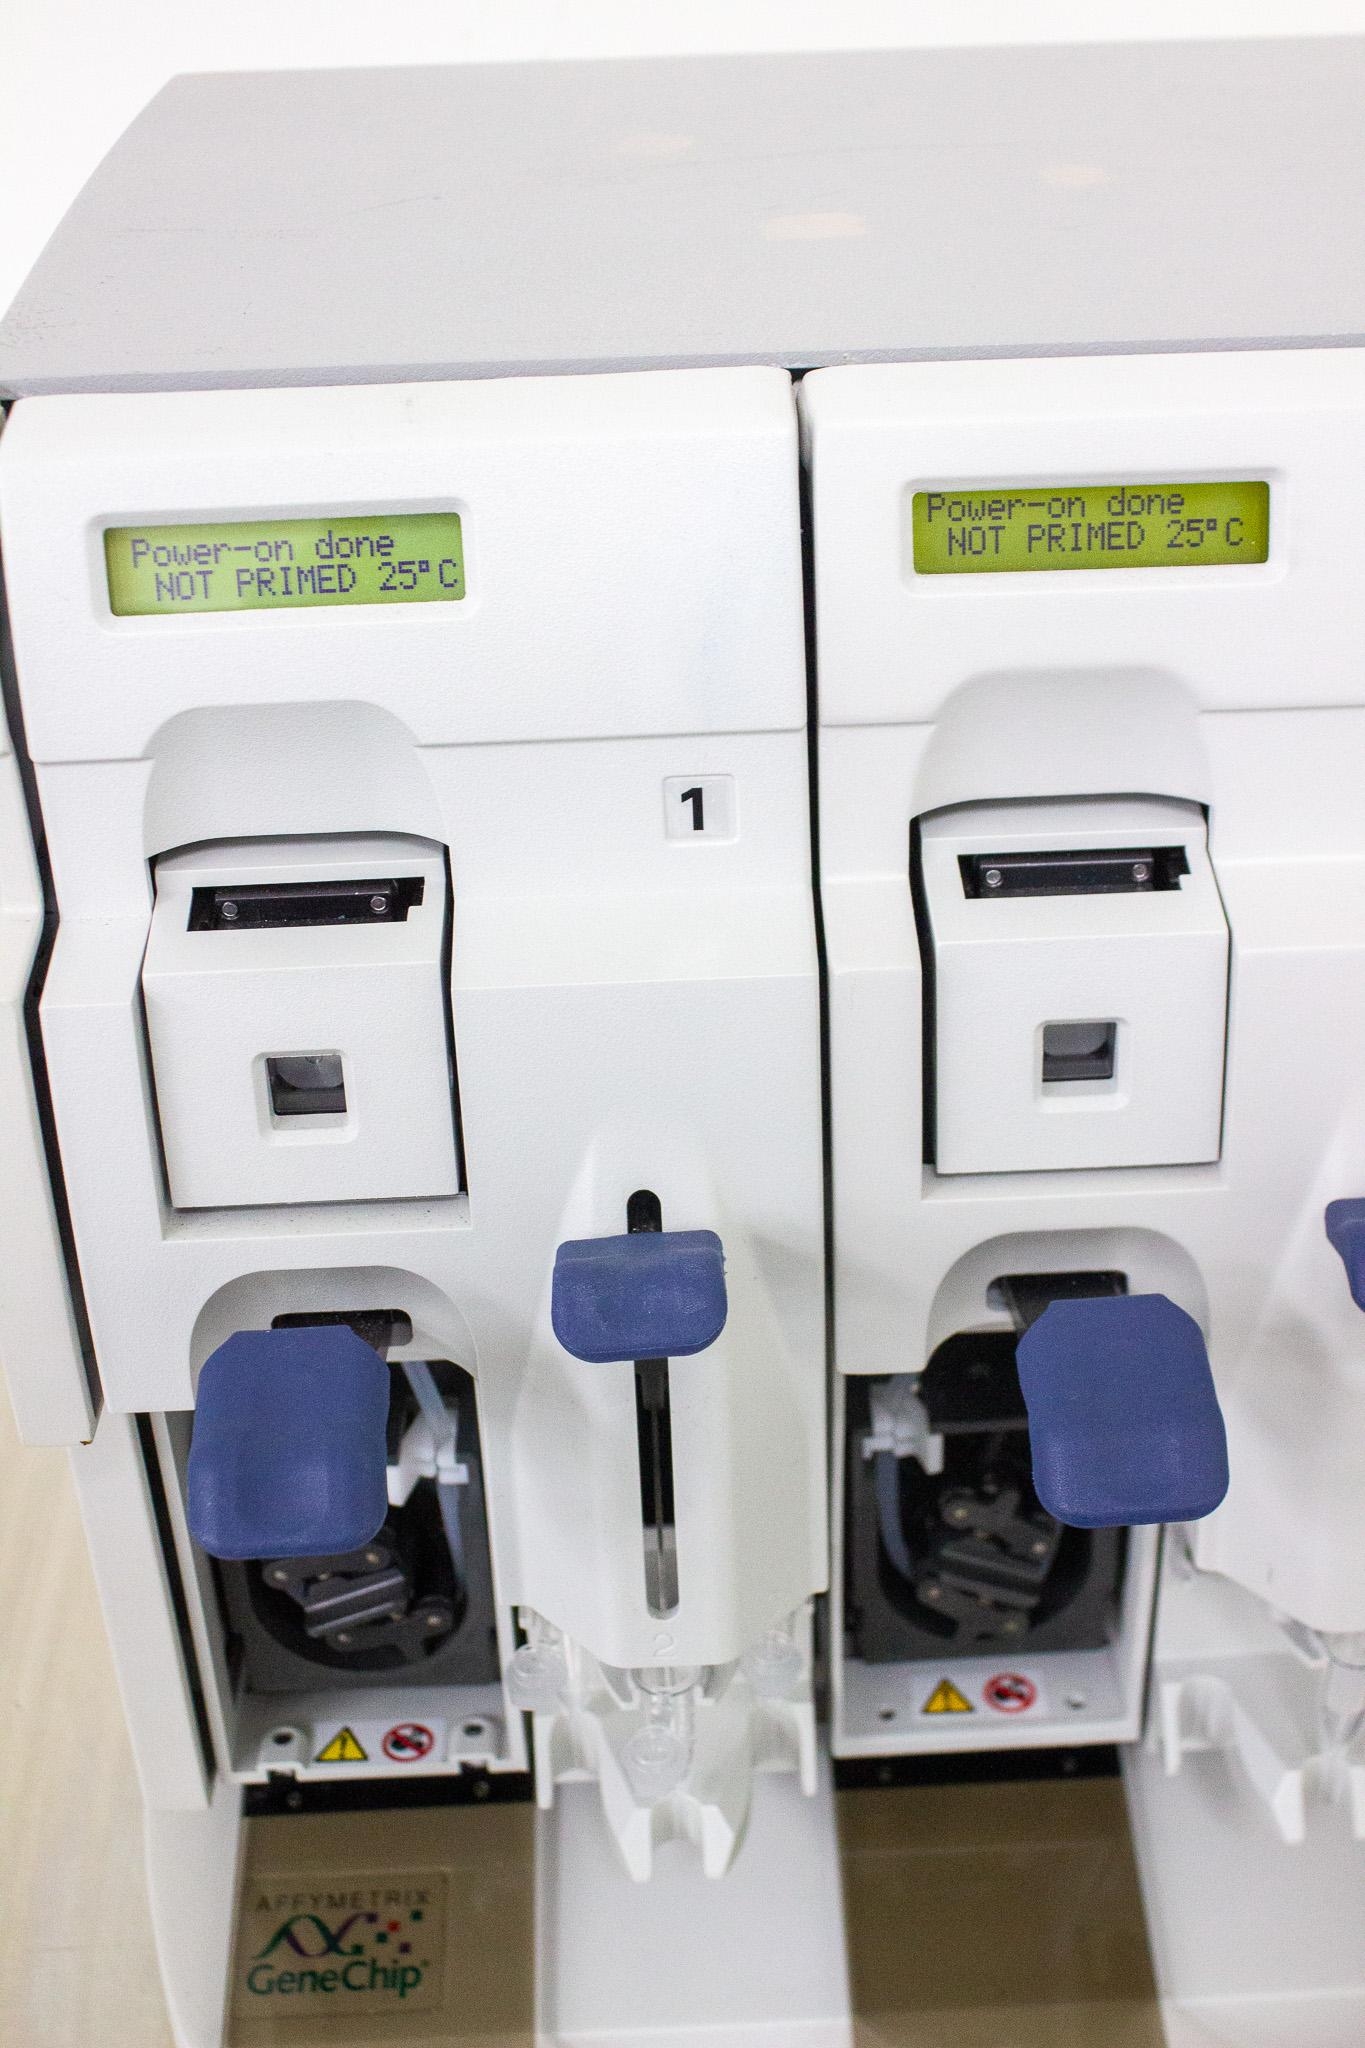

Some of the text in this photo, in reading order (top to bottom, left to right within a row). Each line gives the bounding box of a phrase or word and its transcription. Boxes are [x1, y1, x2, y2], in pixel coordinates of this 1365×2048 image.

[927, 487, 1185, 522] Power-on done
[131, 529, 395, 569] Power-on done
[948, 525, 1006, 556] NOT
[1028, 520, 1145, 553] PRIMED
[155, 570, 213, 601] NOT
[236, 563, 357, 598] PRIMED
[681, 787, 704, 831] 1
[651, 1631, 676, 1658] 2
